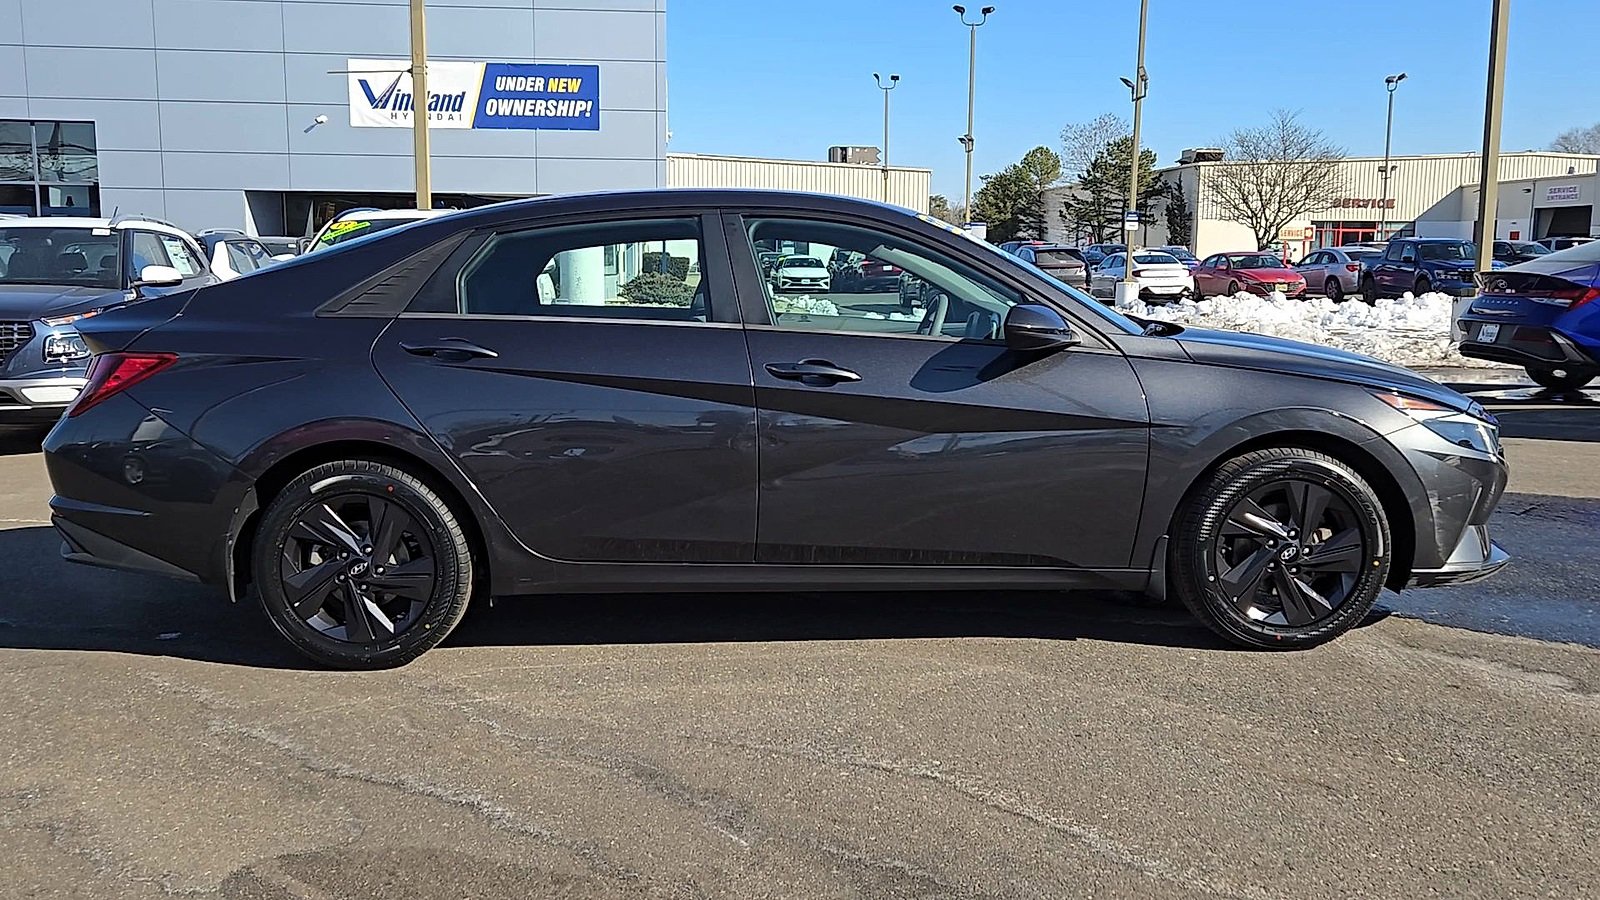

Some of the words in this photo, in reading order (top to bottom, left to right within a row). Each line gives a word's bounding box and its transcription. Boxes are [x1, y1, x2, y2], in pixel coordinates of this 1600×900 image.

[495, 76, 545, 92] UNDER
[547, 77, 582, 93] NEW
[485, 98, 592, 118] OWNERSHIP!
[1548, 186, 1577, 194] SERVICE
[1331, 198, 1396, 210] SERVICE
[1279, 229, 1304, 238] SERVICE
